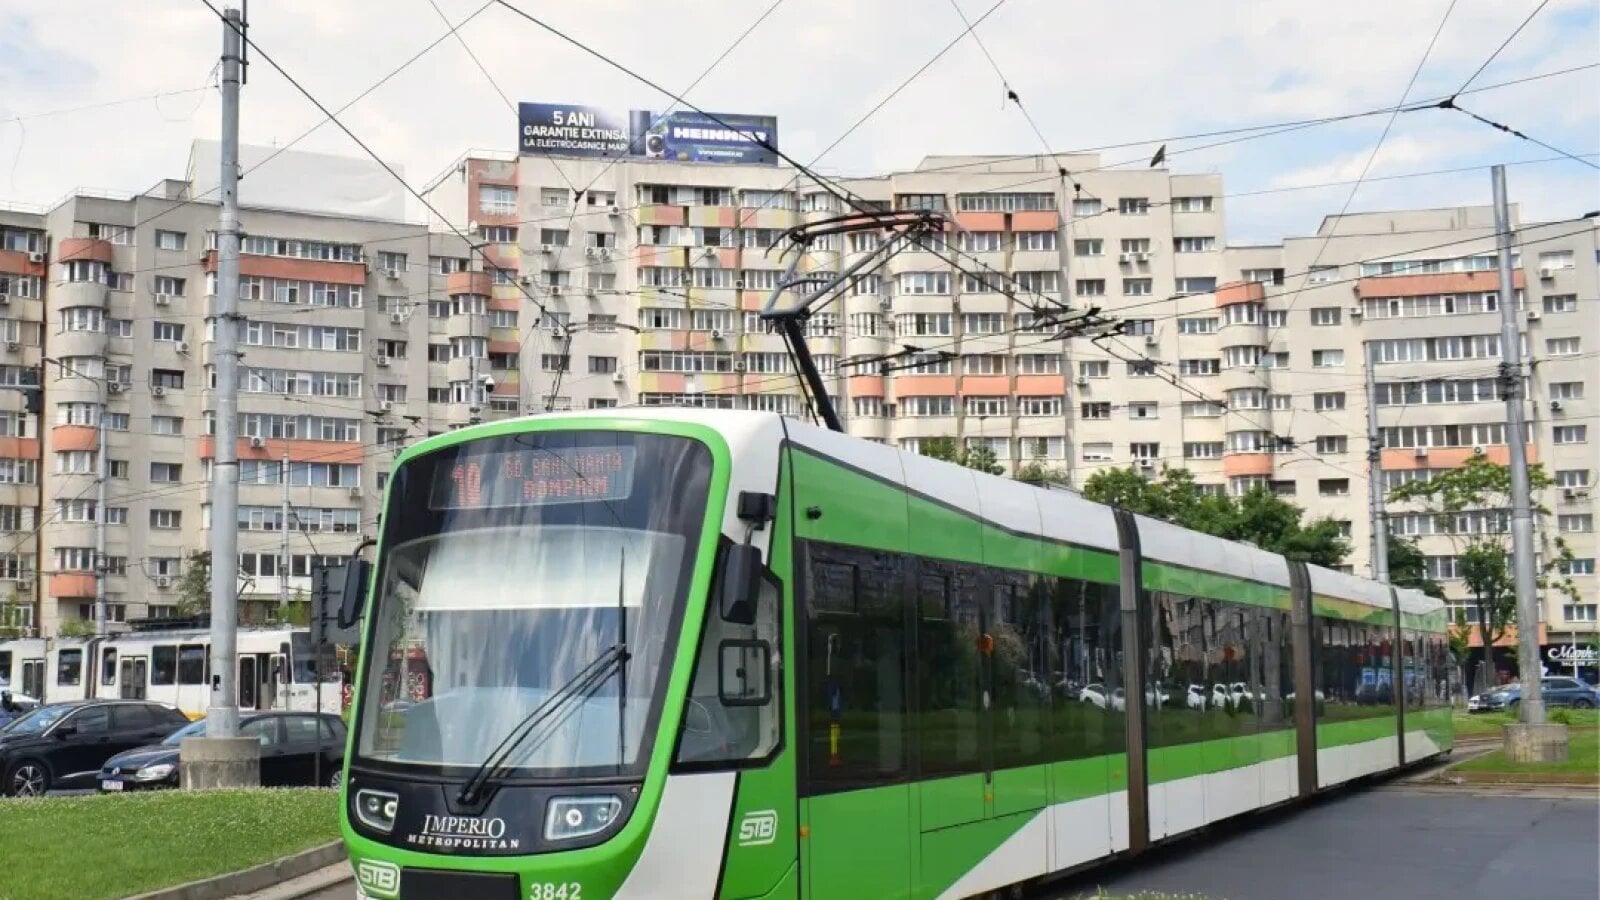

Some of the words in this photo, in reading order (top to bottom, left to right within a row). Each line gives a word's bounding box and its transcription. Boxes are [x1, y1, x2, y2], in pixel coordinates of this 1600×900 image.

[553, 110, 564, 125] 5
[566, 111, 595, 127] ANI
[523, 138, 536, 147] LA
[537, 139, 606, 150] ELECTROCASNICE
[421, 814, 506, 839] IMPERIO
[738, 817, 775, 840] STB
[407, 834, 520, 849] METROPOLITAN
[359, 863, 396, 890] STB
[529, 881, 582, 900] 3842
